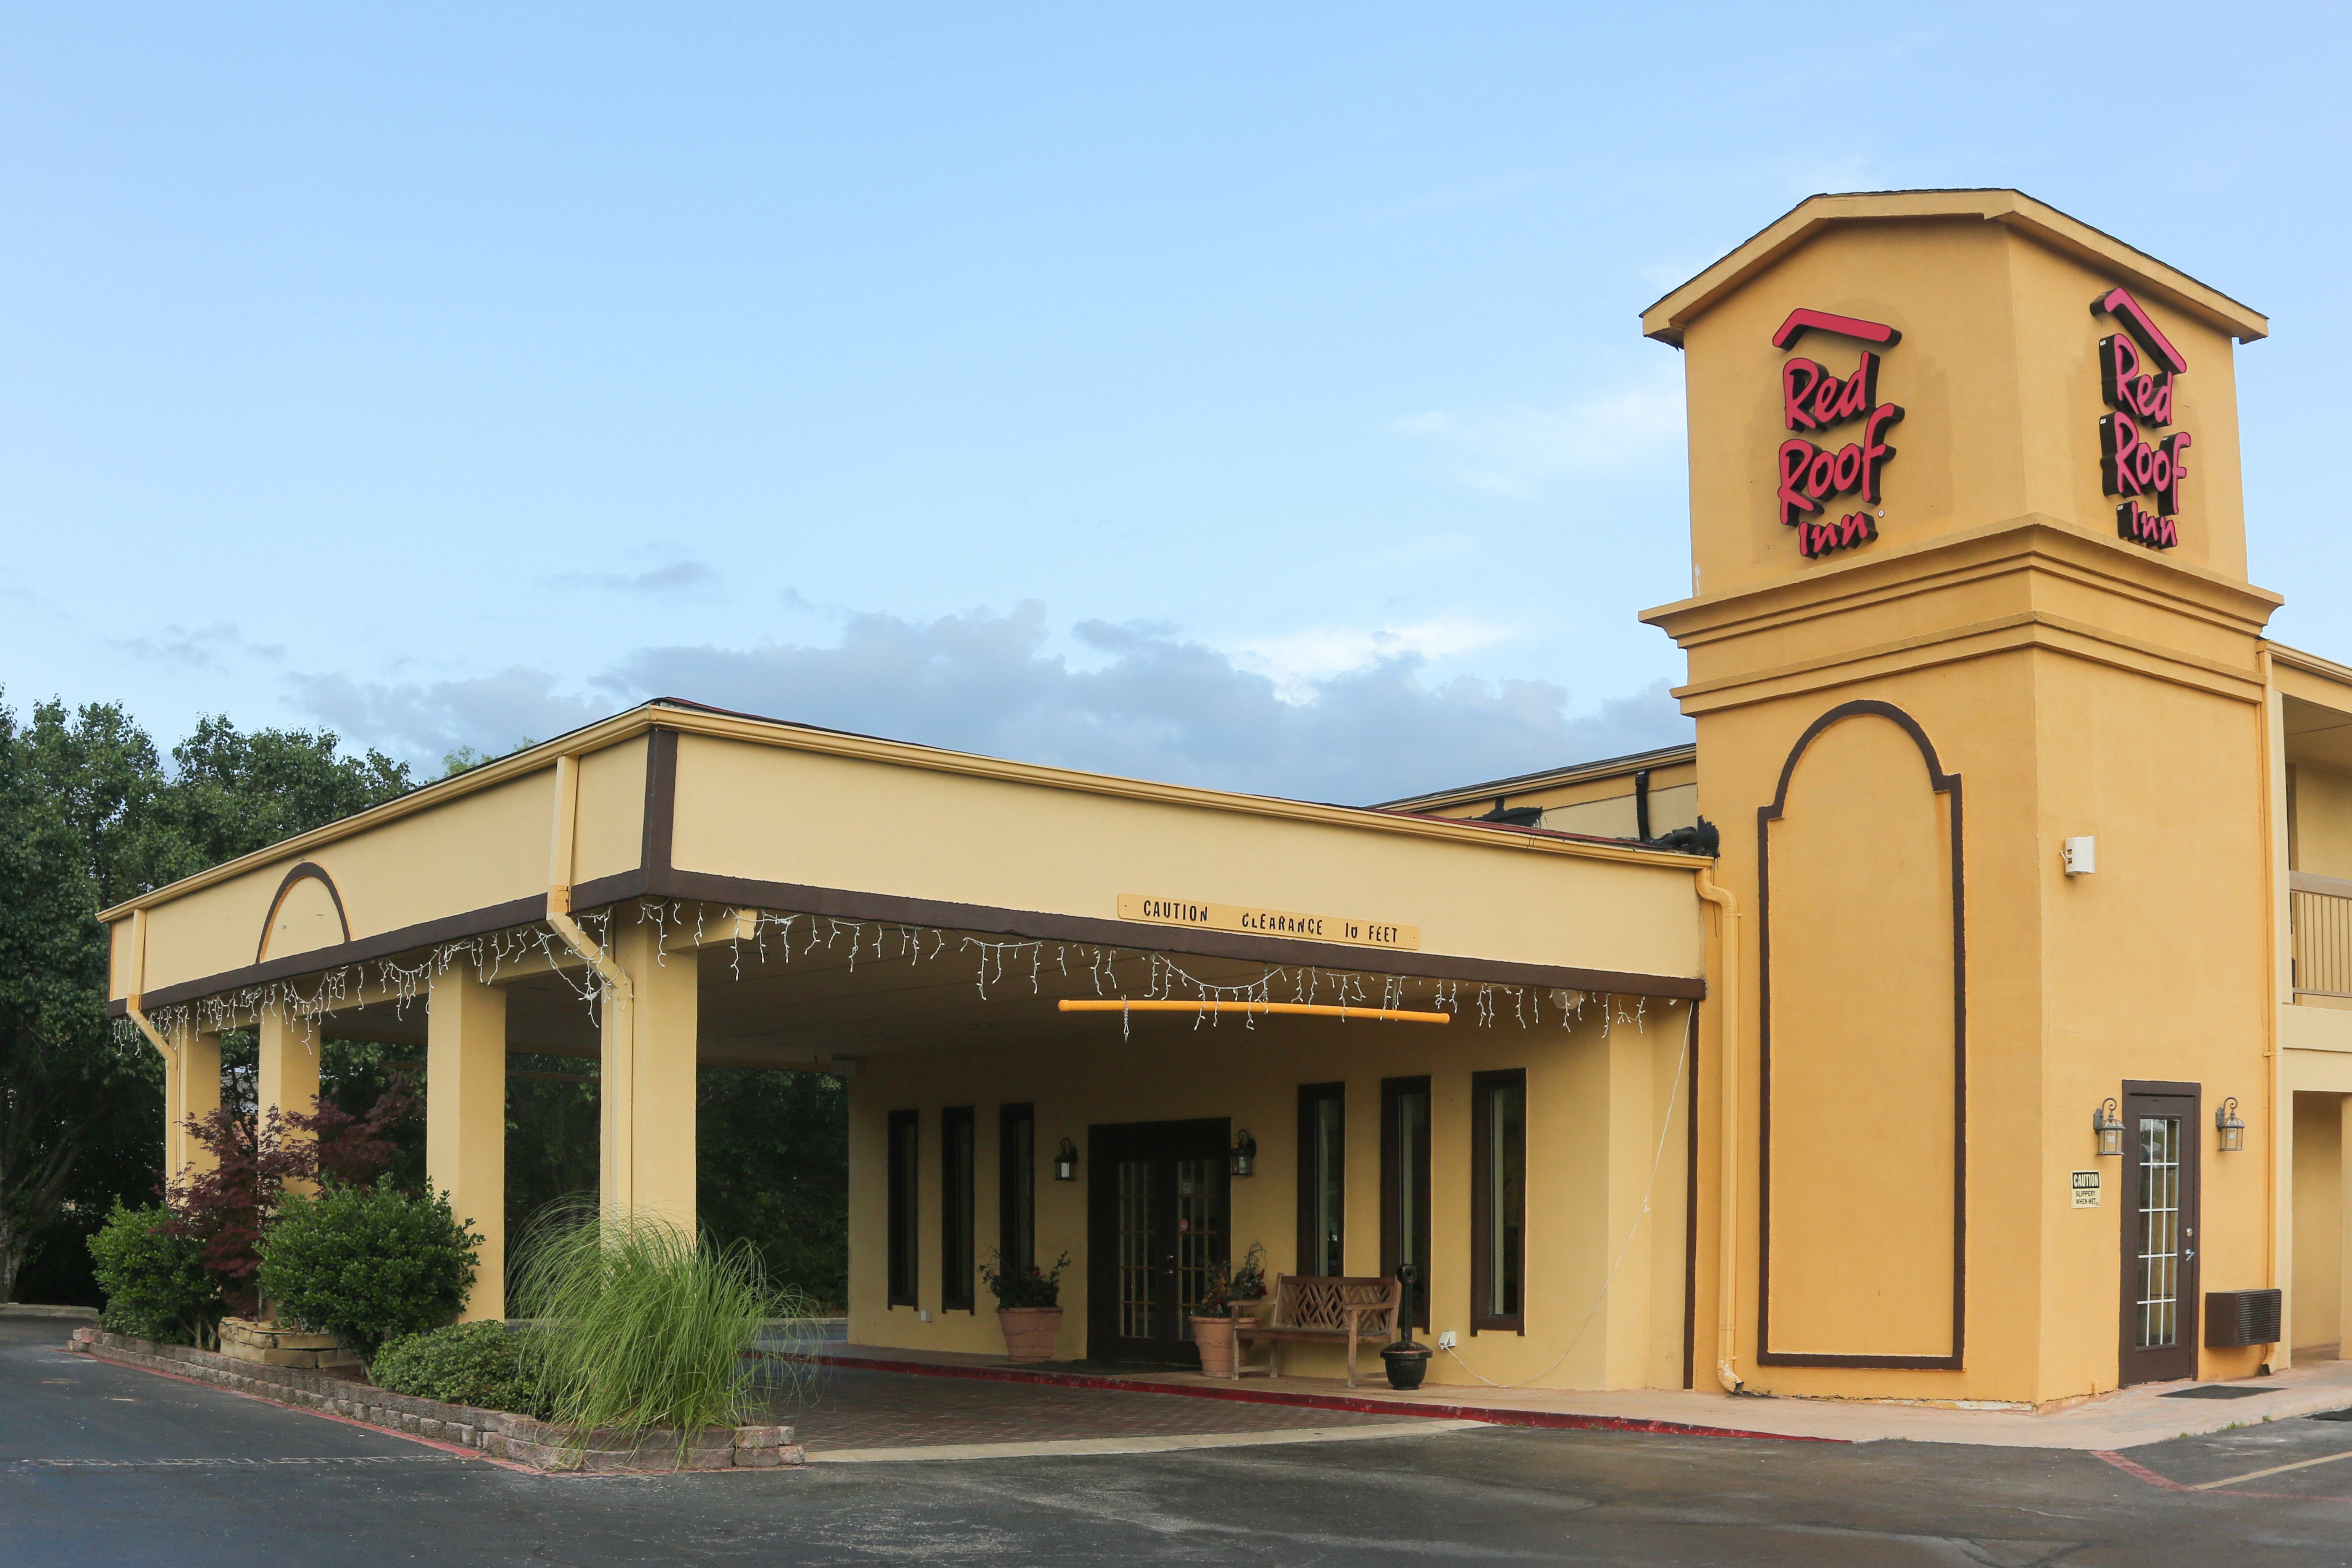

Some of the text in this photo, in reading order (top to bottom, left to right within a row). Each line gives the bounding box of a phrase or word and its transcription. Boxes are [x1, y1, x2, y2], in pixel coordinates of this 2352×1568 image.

[1783, 350, 1870, 430] Red
[2114, 333, 2173, 426] Red
[1777, 403, 1895, 525] Roof
[2114, 411, 2192, 515] Roof
[1799, 511, 1868, 557] Inn
[2131, 501, 2178, 547] Inn
[1143, 900, 1397, 942] CAUTION CLEARANCE 10 FEET
[2073, 1173, 2099, 1187] CAUTION
